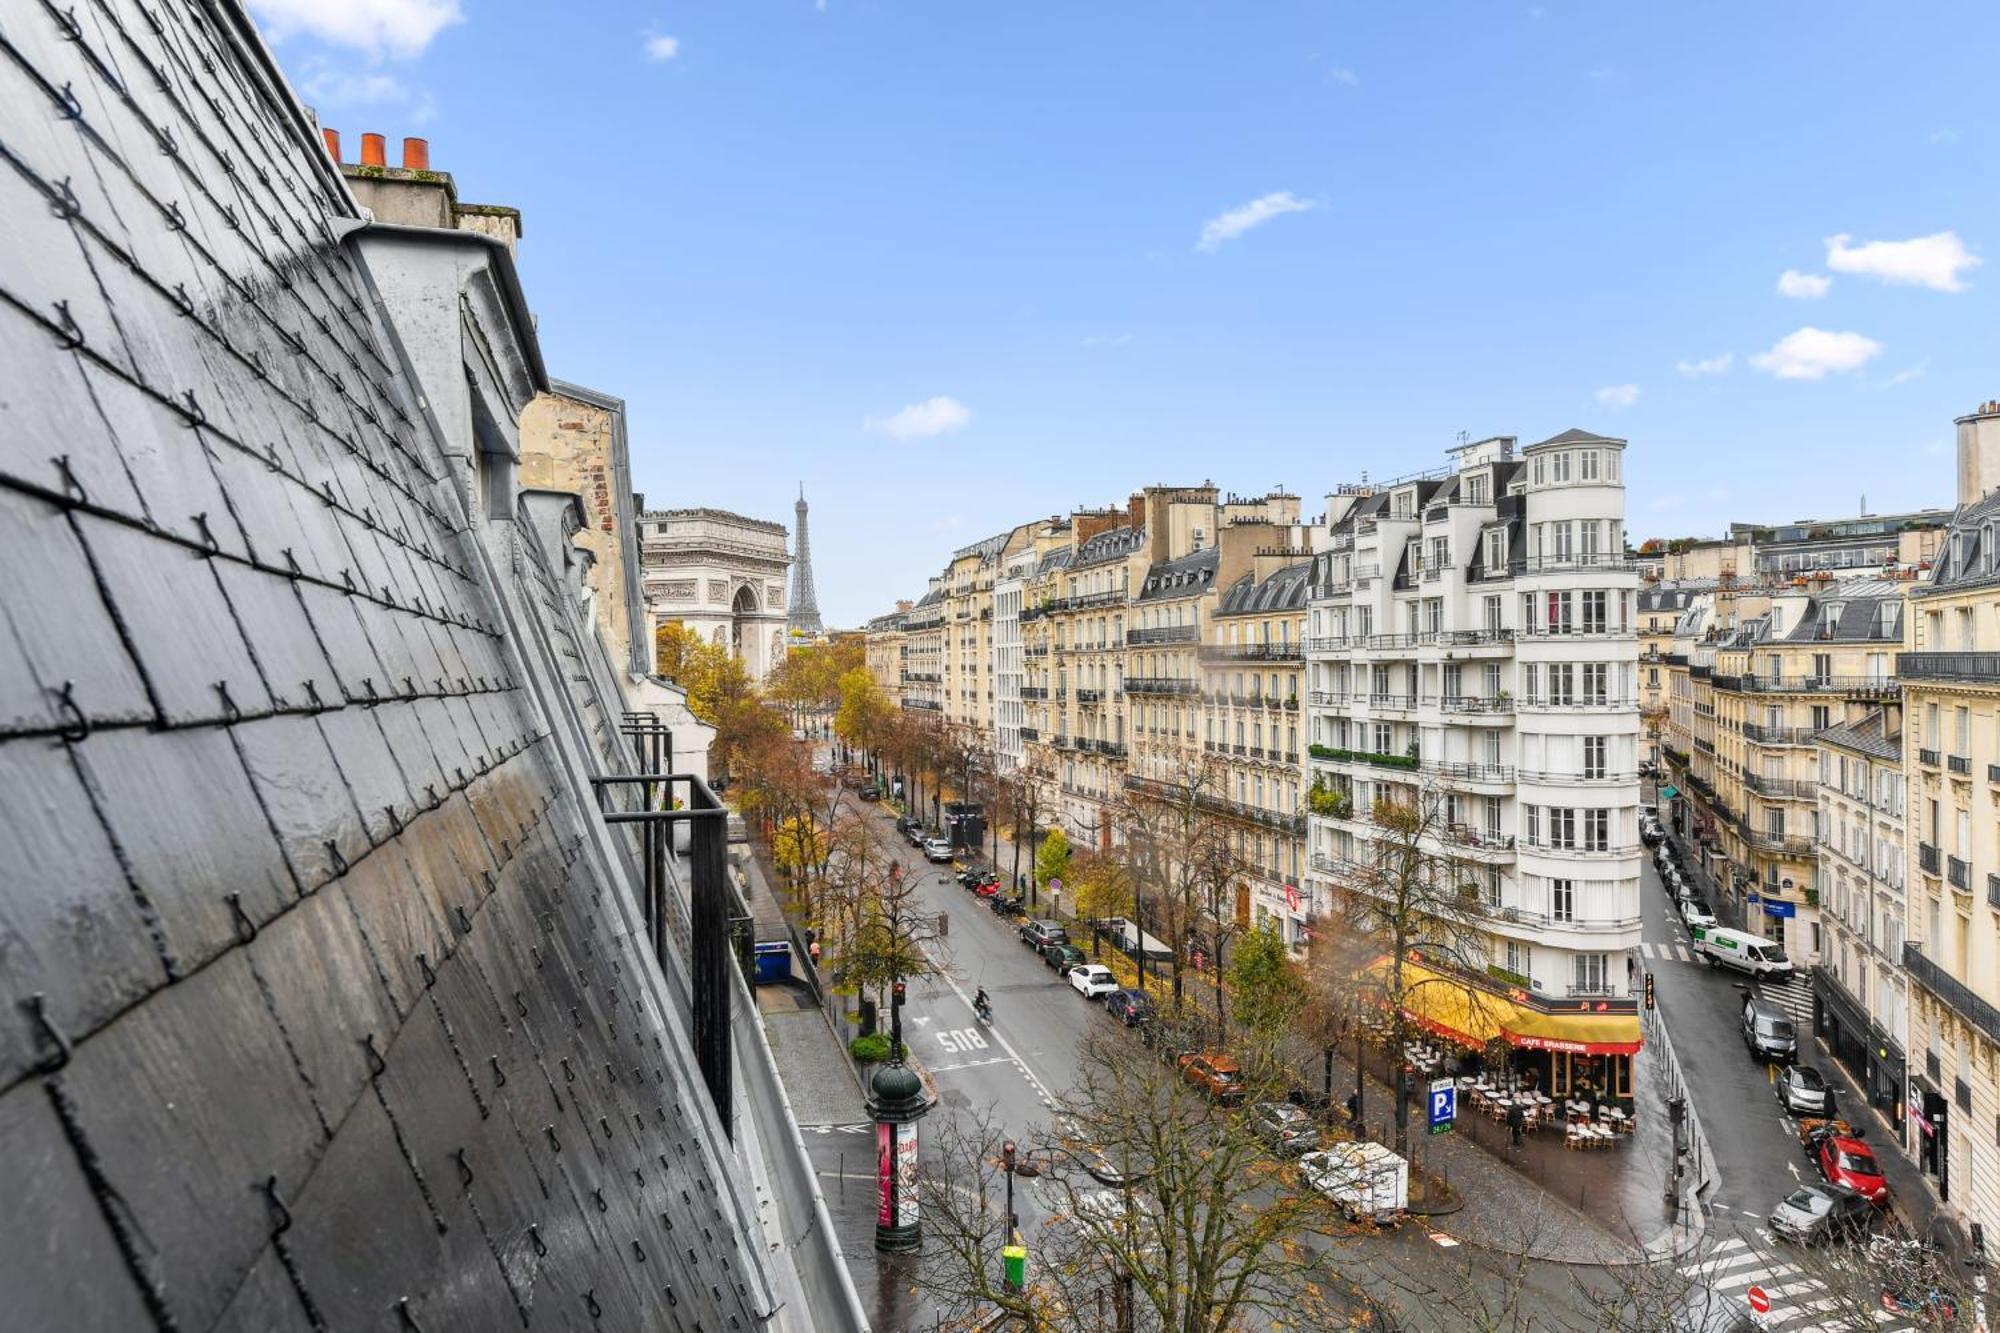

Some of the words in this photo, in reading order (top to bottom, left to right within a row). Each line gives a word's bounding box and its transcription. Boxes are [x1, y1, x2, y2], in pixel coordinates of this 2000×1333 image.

[936, 1027, 989, 1053] BUS
[1543, 1040, 1586, 1052] BRASSERIE
[1434, 1092, 1447, 1116] P
